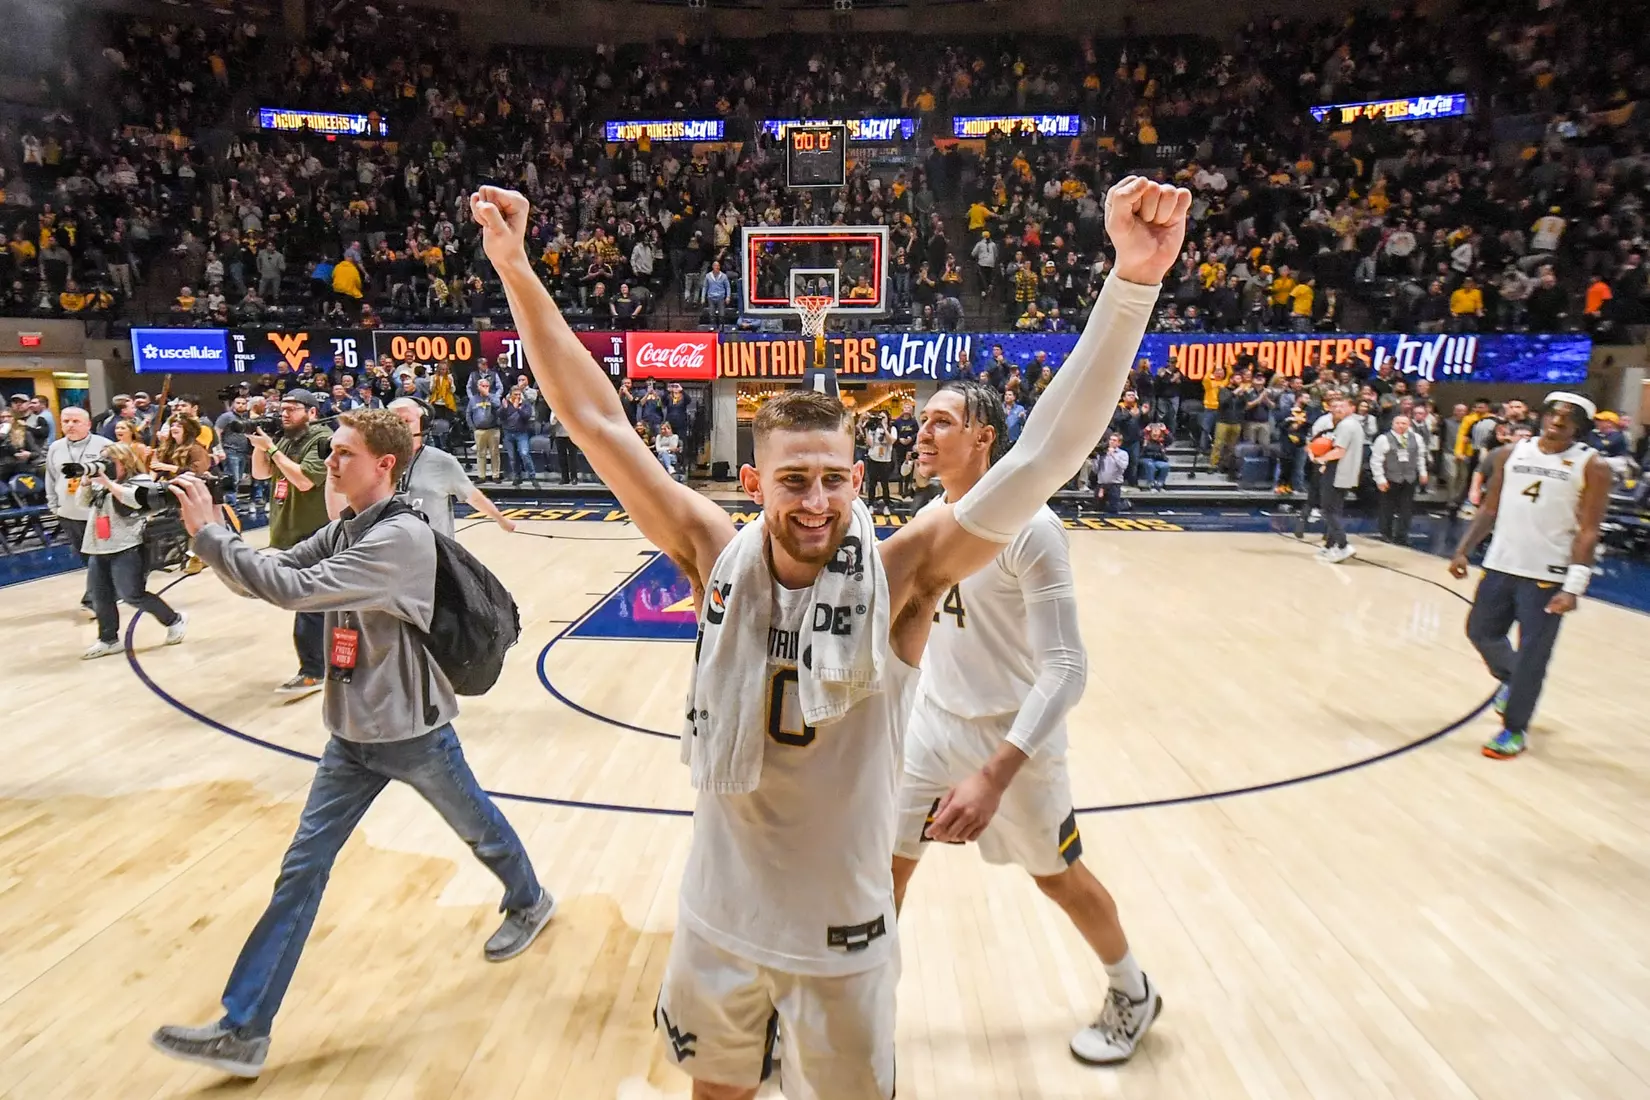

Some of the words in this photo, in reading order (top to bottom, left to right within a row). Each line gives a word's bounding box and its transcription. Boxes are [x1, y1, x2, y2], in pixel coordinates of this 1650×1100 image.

[159, 346, 222, 359] uscellular
[330, 338, 357, 368] 76
[635, 342, 708, 368] Coca-Cola
[234, 360, 245, 372] 10
[610, 362, 620, 375] 10
[1522, 480, 1542, 503] 4
[768, 667, 816, 747] 0
